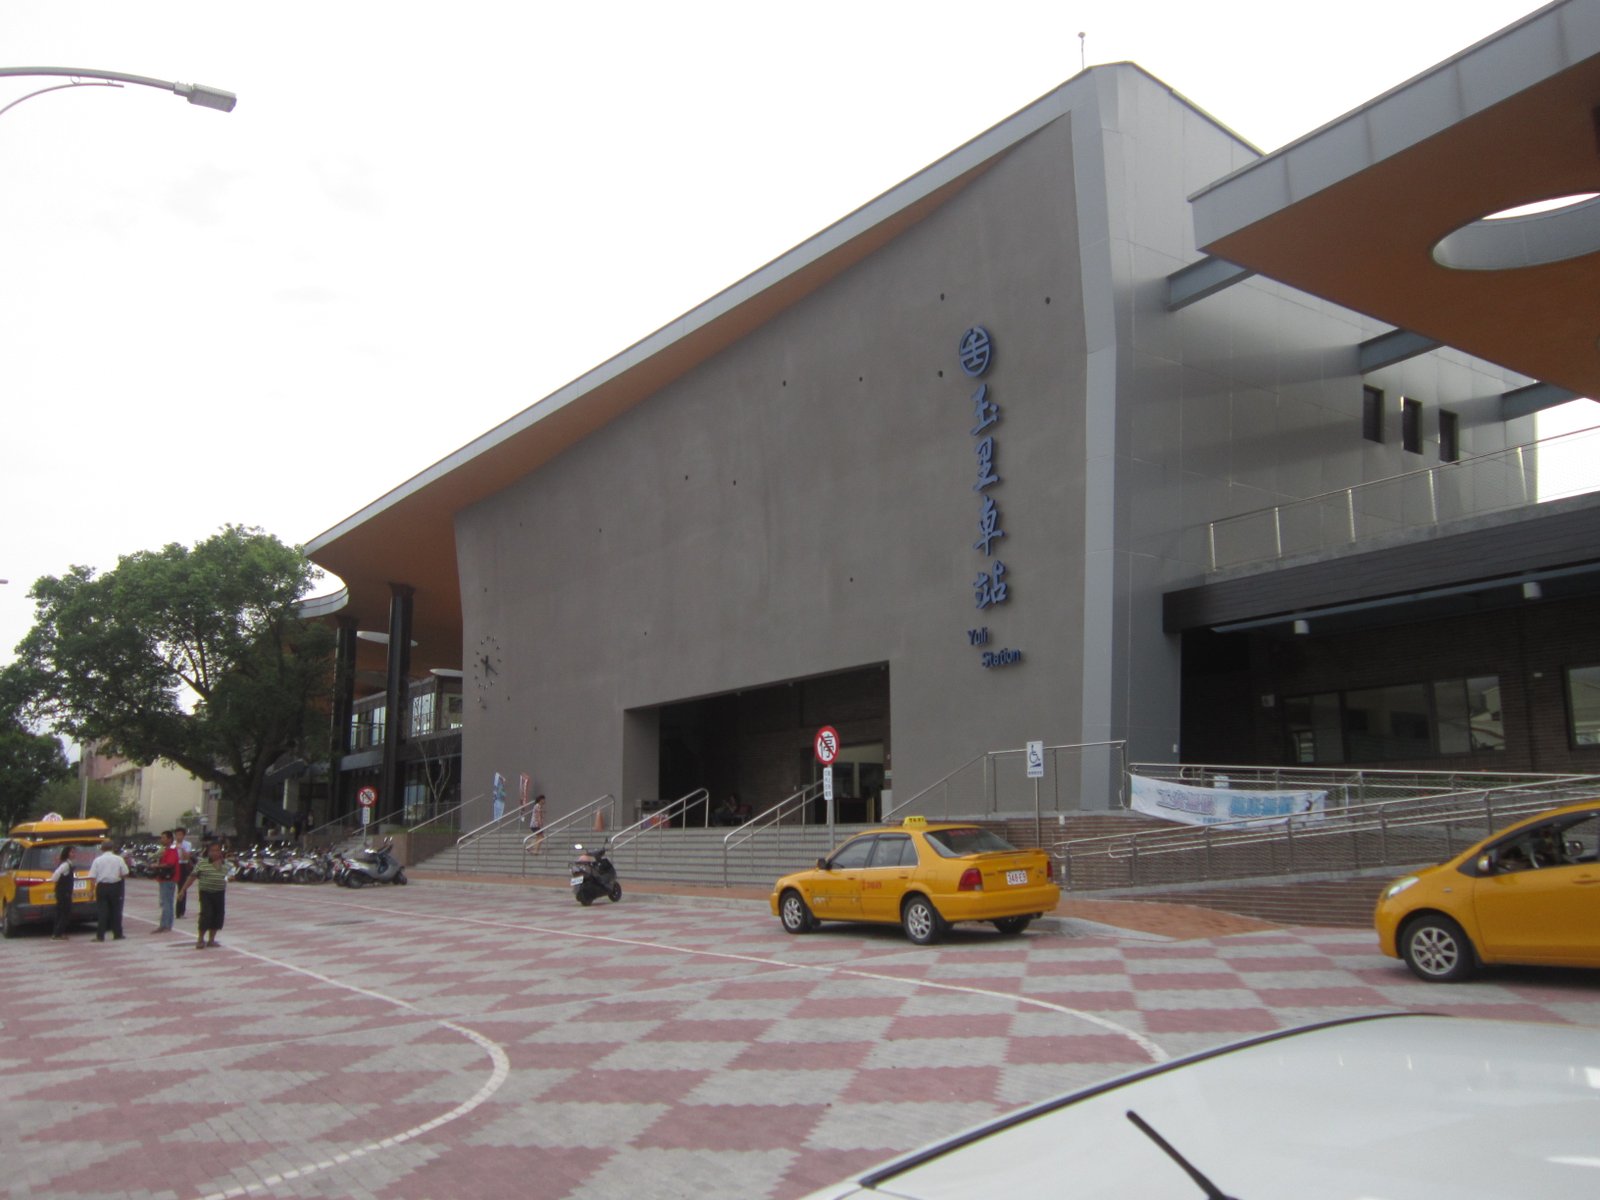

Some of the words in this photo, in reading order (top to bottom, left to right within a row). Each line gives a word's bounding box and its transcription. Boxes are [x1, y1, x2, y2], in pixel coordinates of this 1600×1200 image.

[967, 626, 989, 645] Yuli
[981, 648, 1022, 668] Station
[819, 733, 835, 758] 停
